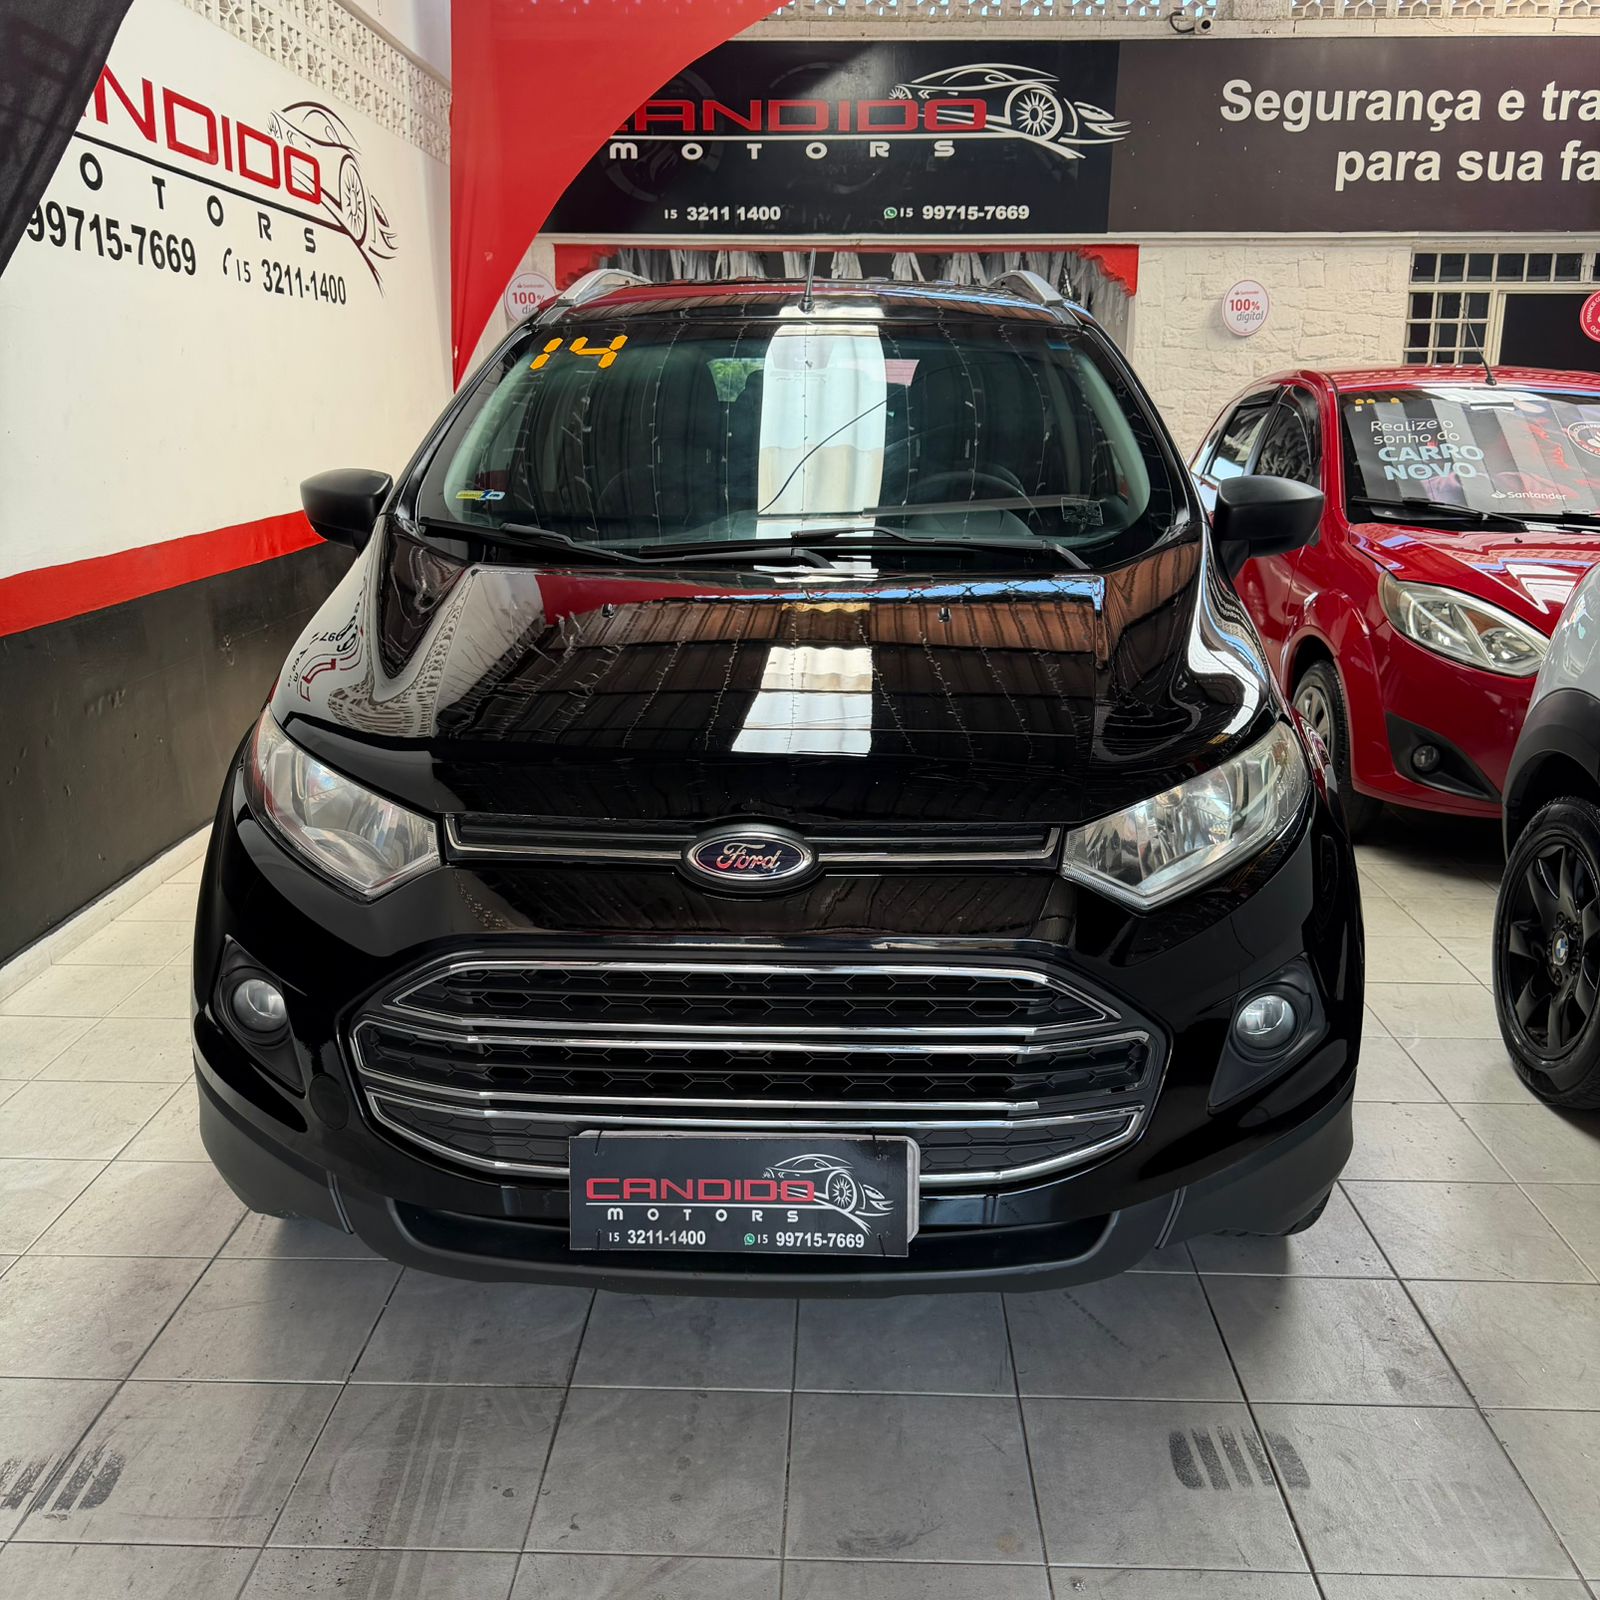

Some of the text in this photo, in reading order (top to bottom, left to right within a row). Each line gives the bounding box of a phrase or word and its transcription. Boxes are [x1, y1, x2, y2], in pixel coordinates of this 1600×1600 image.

[1220, 79, 1600, 132] Segurança e tra
[616, 99, 987, 132] ANDIDO
[82, 63, 322, 205] NDIDO
[1335, 139, 1600, 192] para sua fa
[79, 152, 316, 254] OTORS
[664, 206, 782, 221] 15 3211 1400
[900, 205, 1030, 221] 15 99715-7669
[26, 200, 196, 277] 99715-7669
[261, 258, 347, 305] 3211-1400
[1230, 299, 1260, 311] 100%
[1236, 310, 1264, 324] digital
[530, 335, 628, 369] 14
[1370, 419, 1454, 433] Realize o
[1373, 430, 1460, 445] sonho do
[1378, 444, 1484, 463] CARRO
[1384, 462, 1477, 481] NOVO
[1507, 491, 1567, 501] Santander
[716, 842, 782, 870] Ford
[585, 1177, 815, 1202] CANDIDO
[608, 1230, 706, 1246] 15 3211-1400
[756, 1231, 865, 1248] 15 99715-7669
